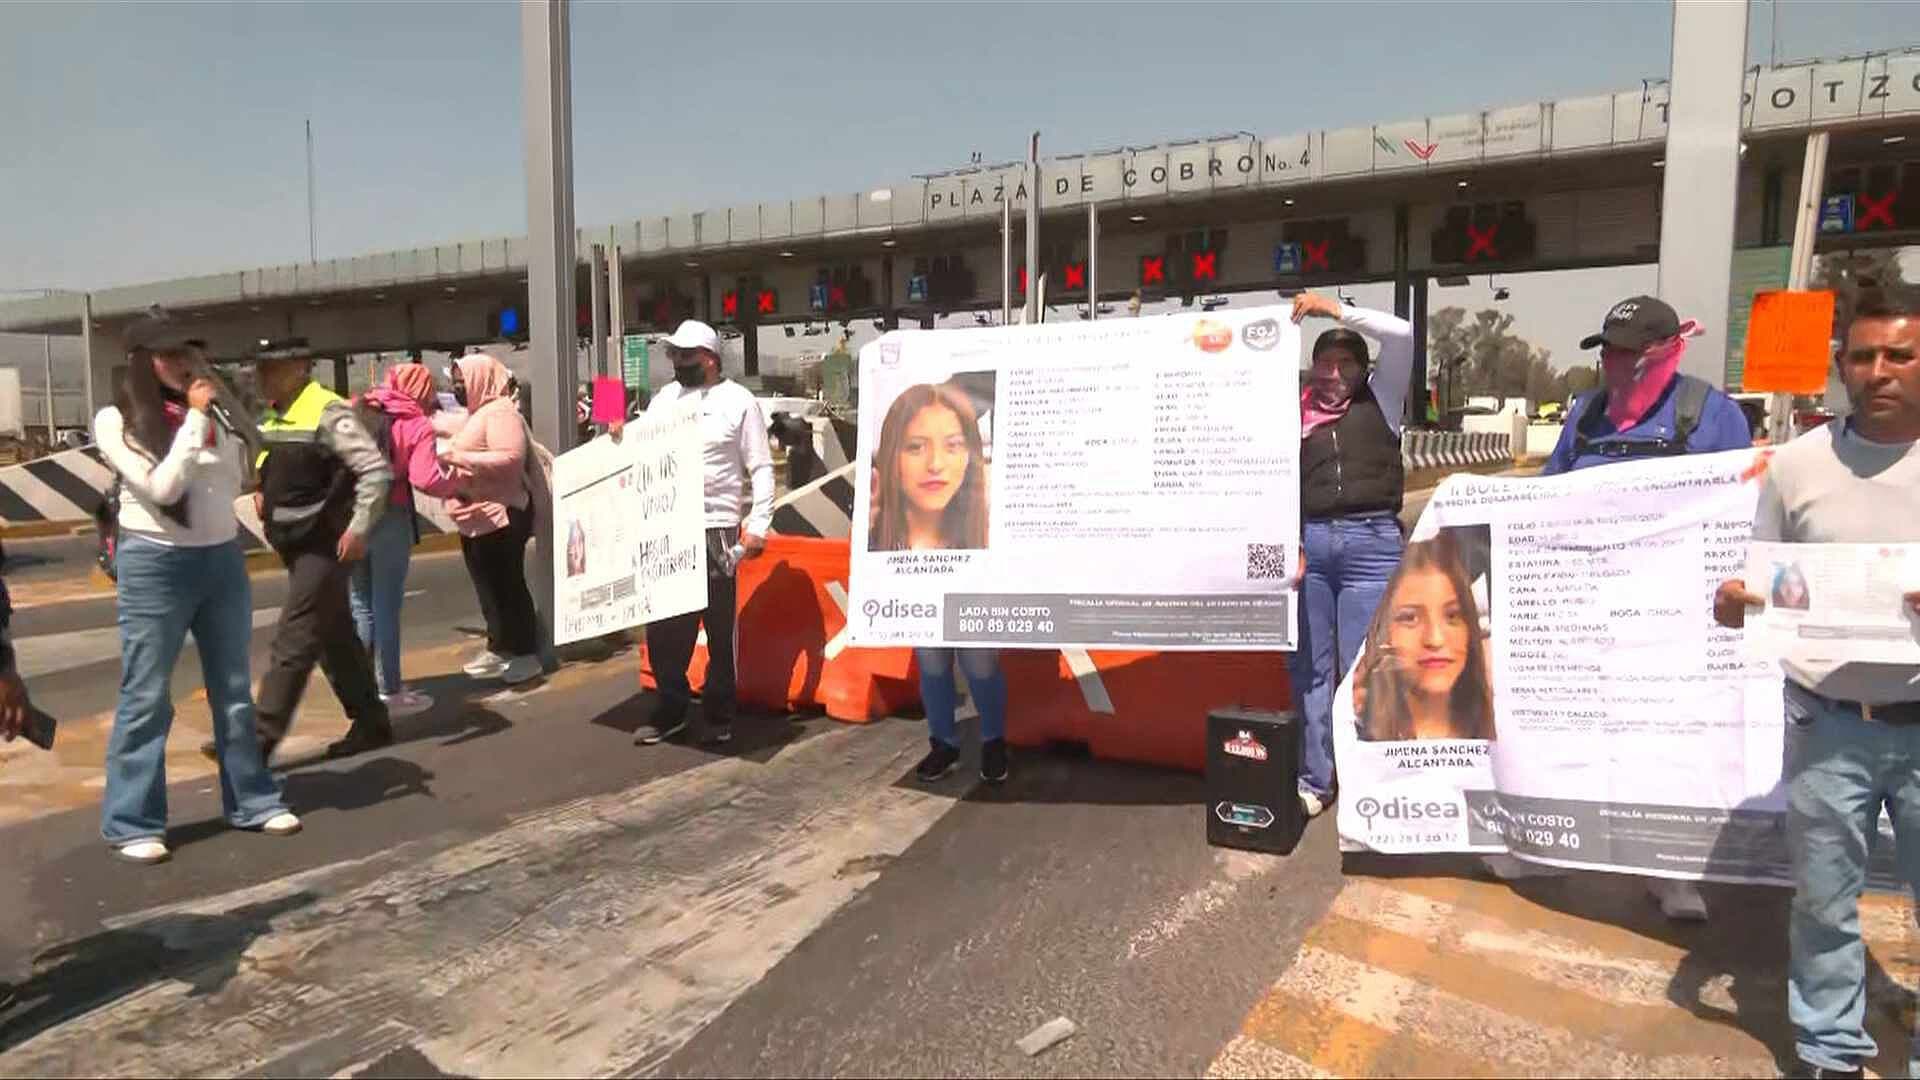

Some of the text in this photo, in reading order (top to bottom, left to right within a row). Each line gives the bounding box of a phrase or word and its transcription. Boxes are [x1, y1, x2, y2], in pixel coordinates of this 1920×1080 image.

[931, 149, 1311, 209] PLAZA DE COBRO No. 4
[959, 619, 984, 633] 800
[987, 619, 1004, 633] 89
[1007, 619, 1033, 633] 029
[1037, 619, 1054, 633] 40
[1385, 744, 1491, 758] JIMENA SANCHEZ
[1397, 758, 1475, 769] ALCANTARA
[1527, 814, 1577, 829] COSTO
[1559, 831, 1580, 849] 40
